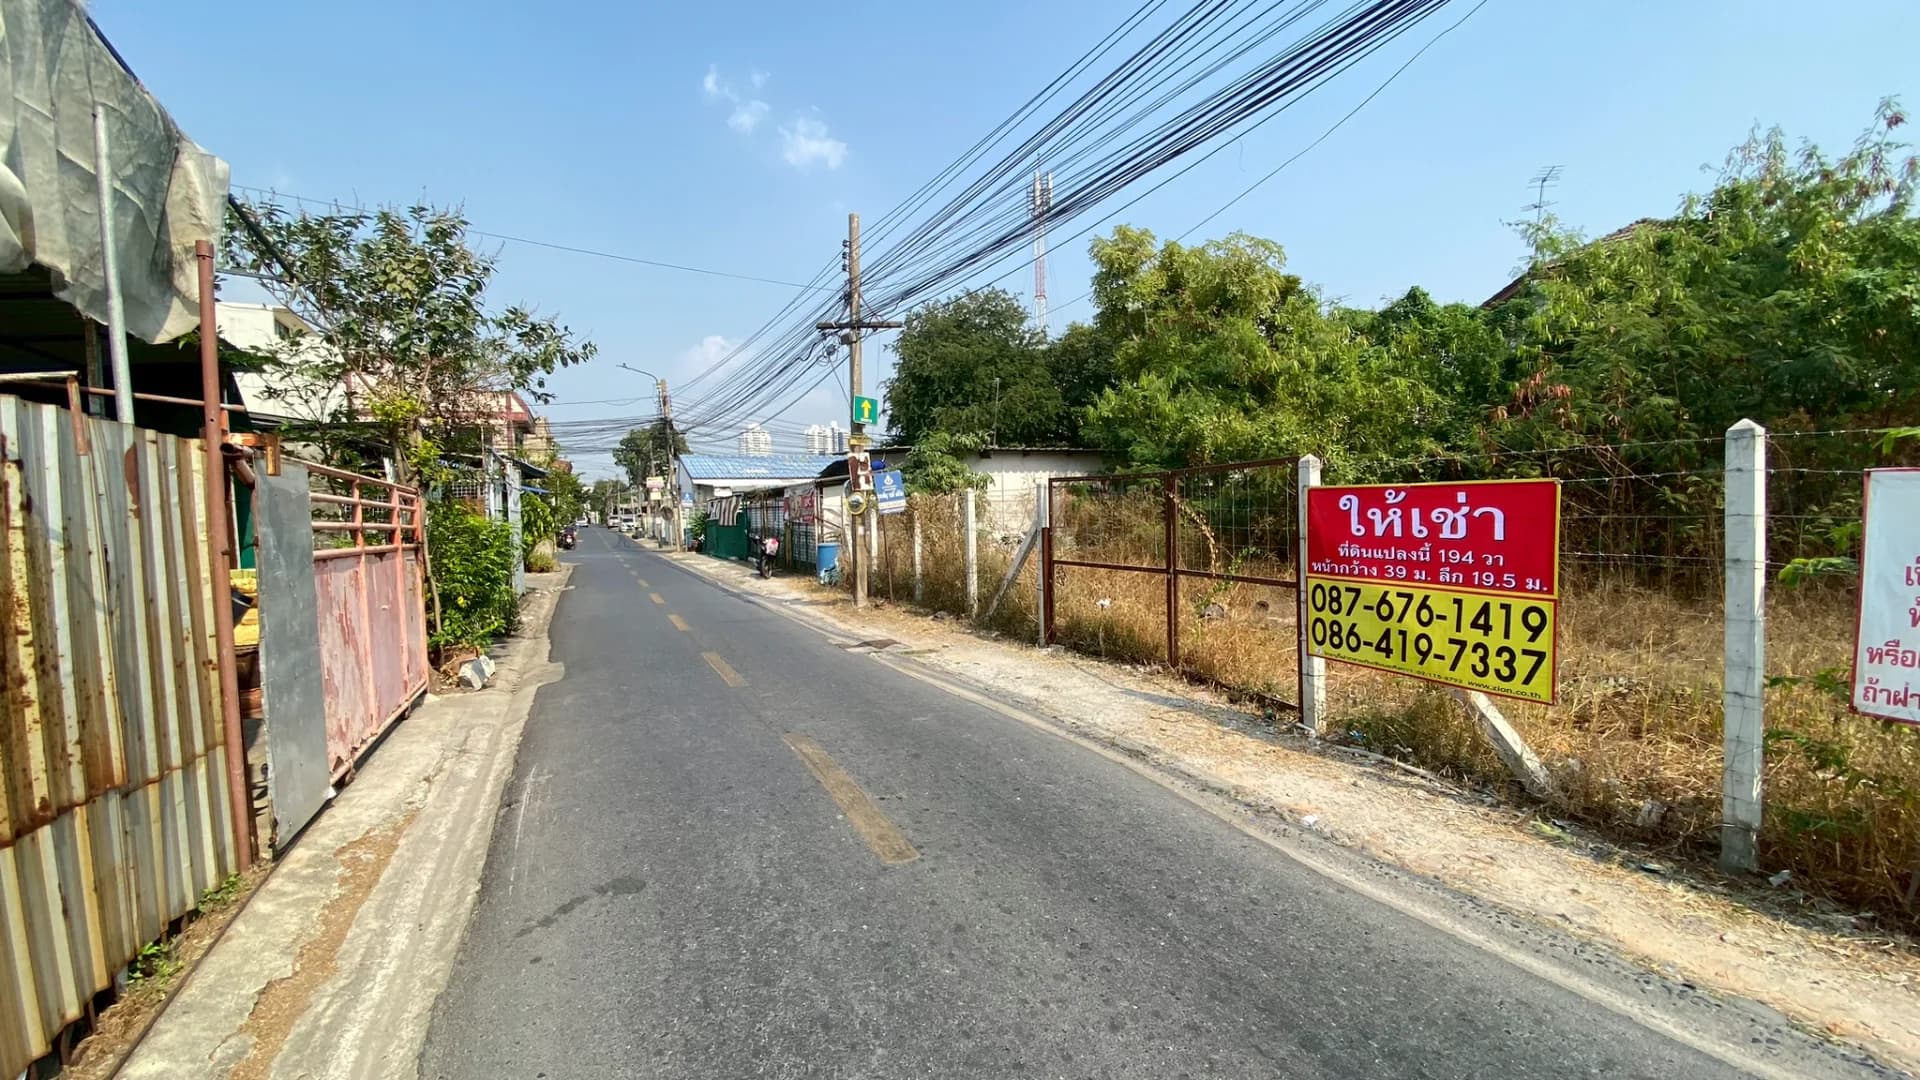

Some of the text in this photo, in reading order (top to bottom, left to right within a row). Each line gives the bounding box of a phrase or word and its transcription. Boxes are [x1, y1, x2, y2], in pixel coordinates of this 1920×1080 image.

[1338, 488, 1505, 541] ให้เช่า
[1311, 559, 1549, 592] หน้ากว้าง 39 ม. ลึก 19.5 ม.
[1337, 541, 1505, 567] ที่ดินแปลงนี้ 194 วา
[1311, 583, 1548, 644] 087-676-1419
[1311, 616, 1548, 686] 086-419-7337
